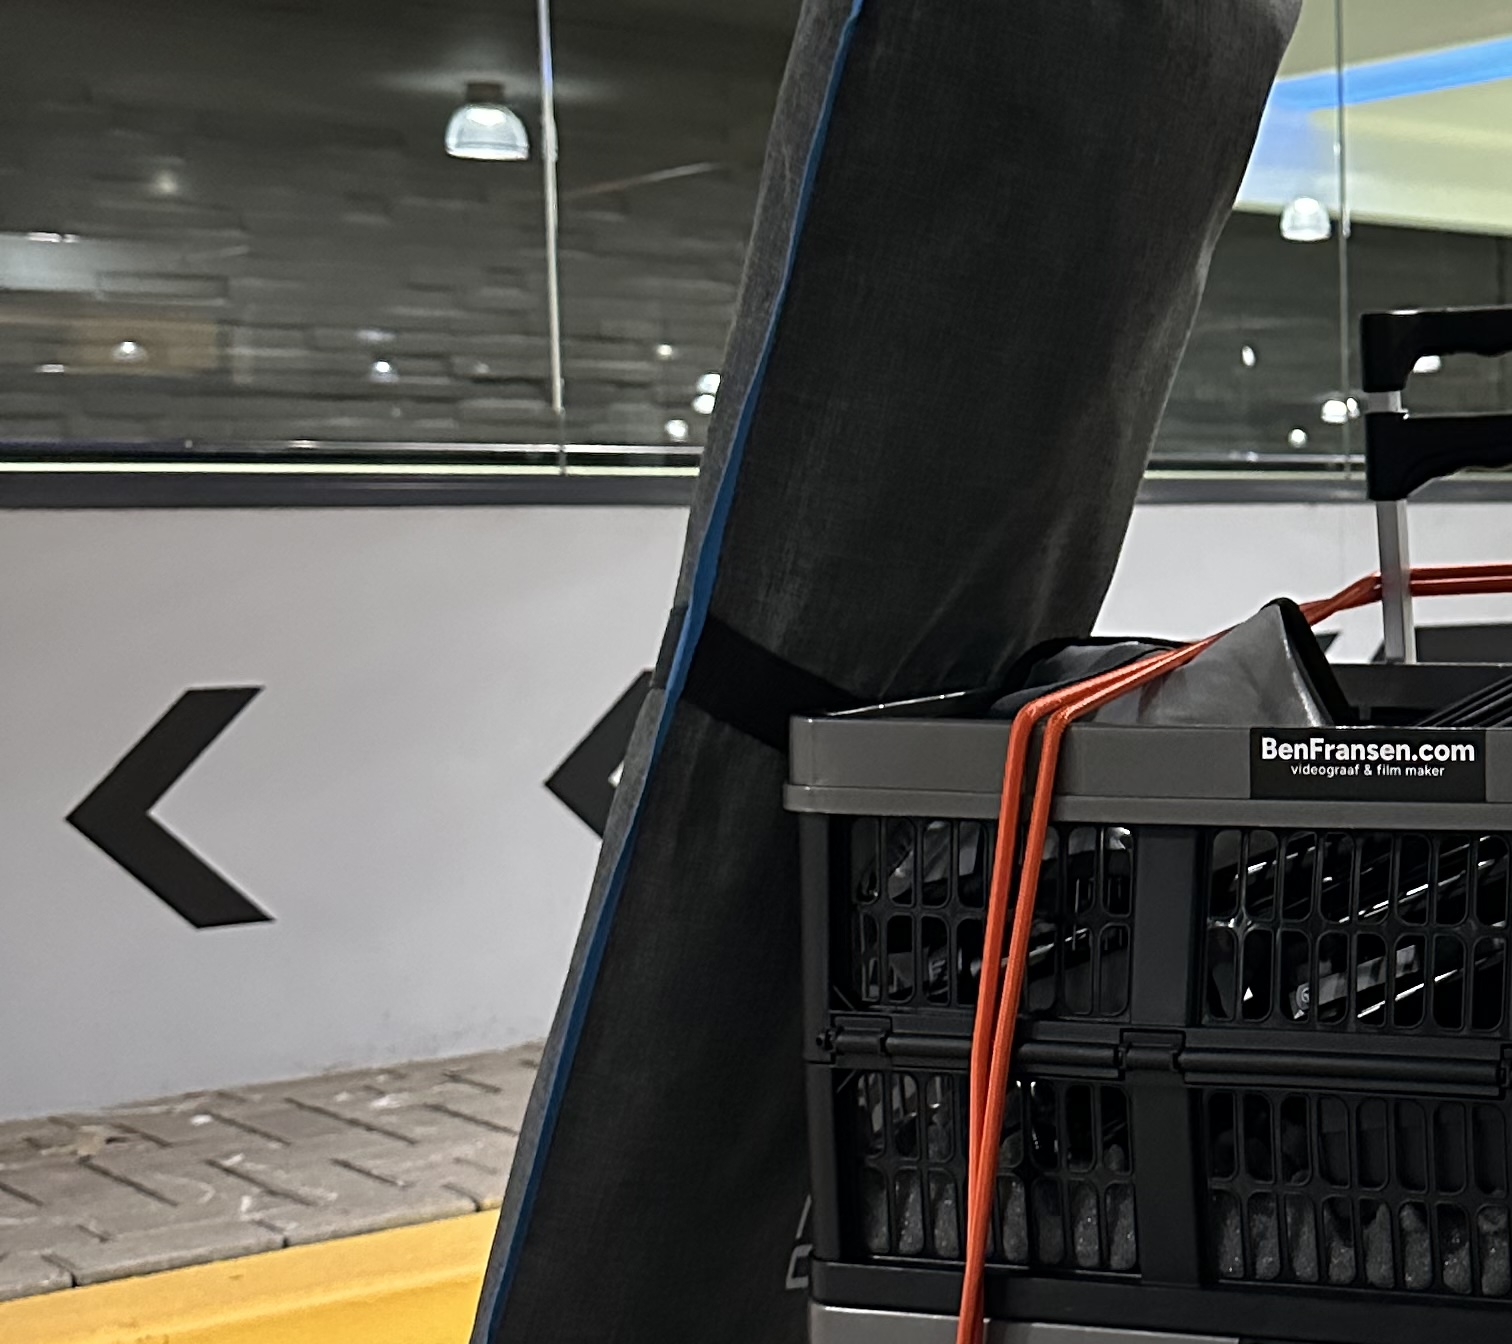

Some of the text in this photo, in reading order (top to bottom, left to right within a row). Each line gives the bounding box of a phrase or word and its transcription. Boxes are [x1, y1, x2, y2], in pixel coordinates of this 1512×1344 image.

[1261, 736, 1475, 762] BenFransen.com
[1290, 763, 1445, 778] videograaf & film maker
